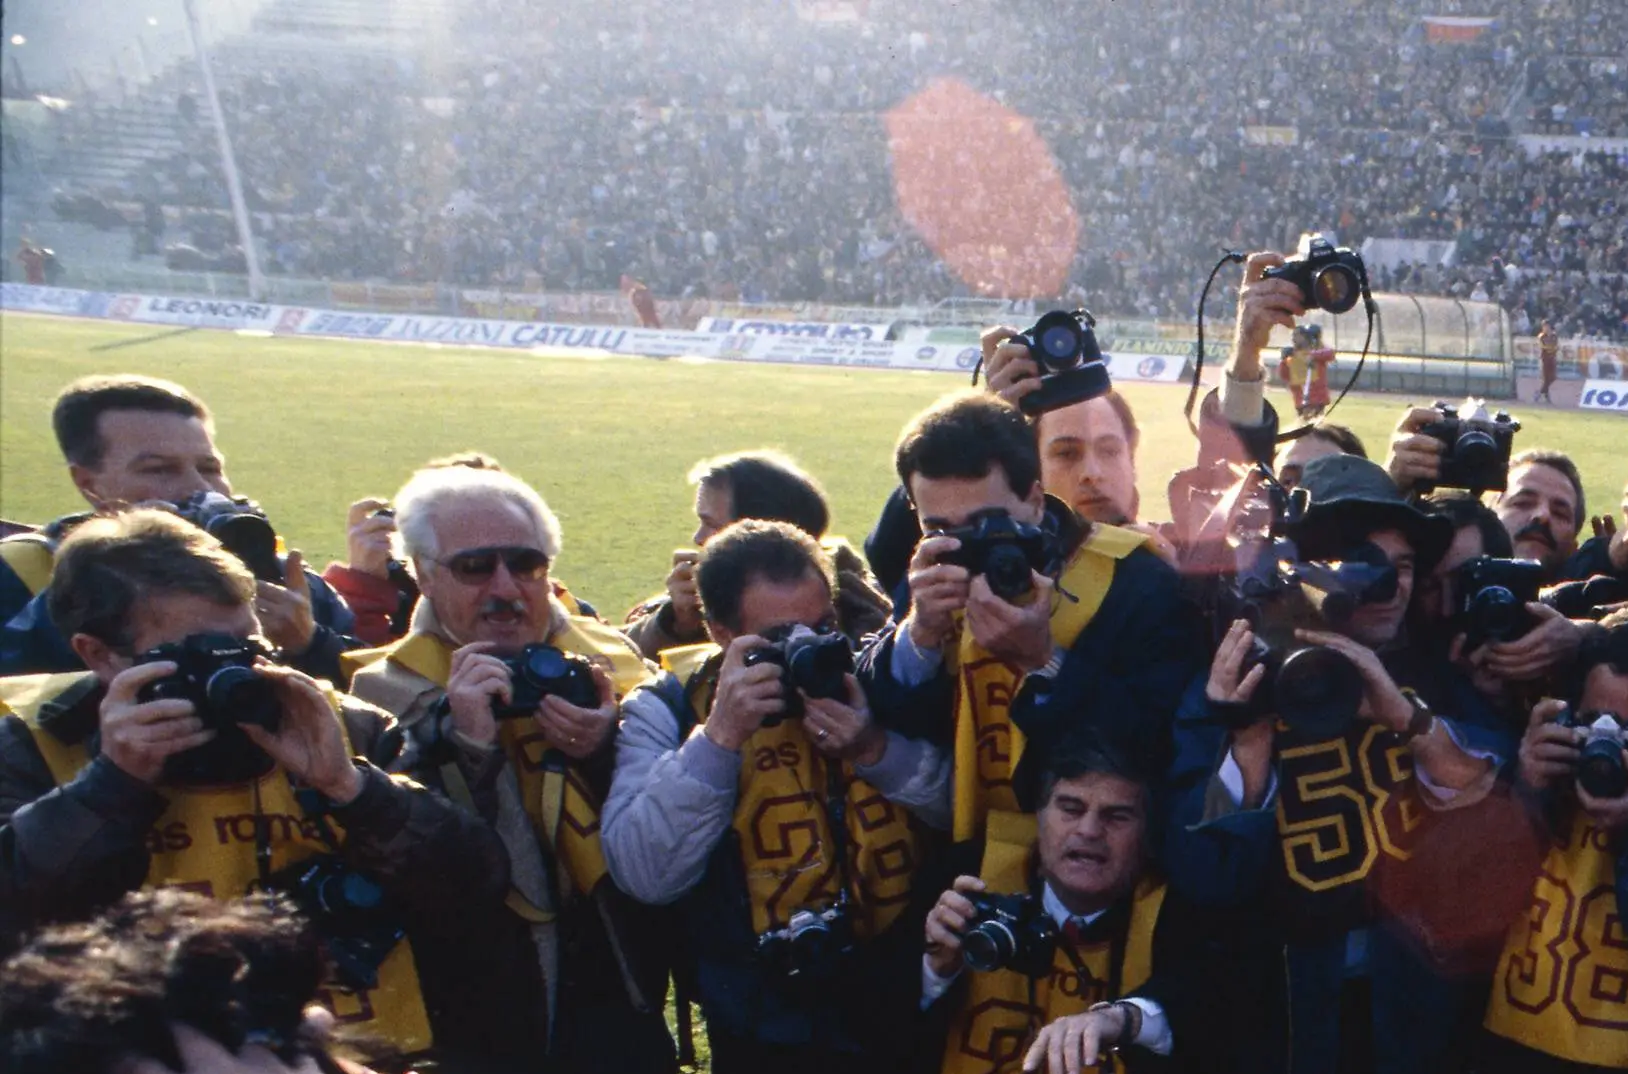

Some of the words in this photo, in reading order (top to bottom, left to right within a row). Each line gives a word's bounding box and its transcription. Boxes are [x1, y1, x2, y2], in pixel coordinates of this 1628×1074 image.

[150, 299, 271, 320] LEONORI
[511, 324, 627, 349] CATULLI
[755, 741, 801, 772] as
